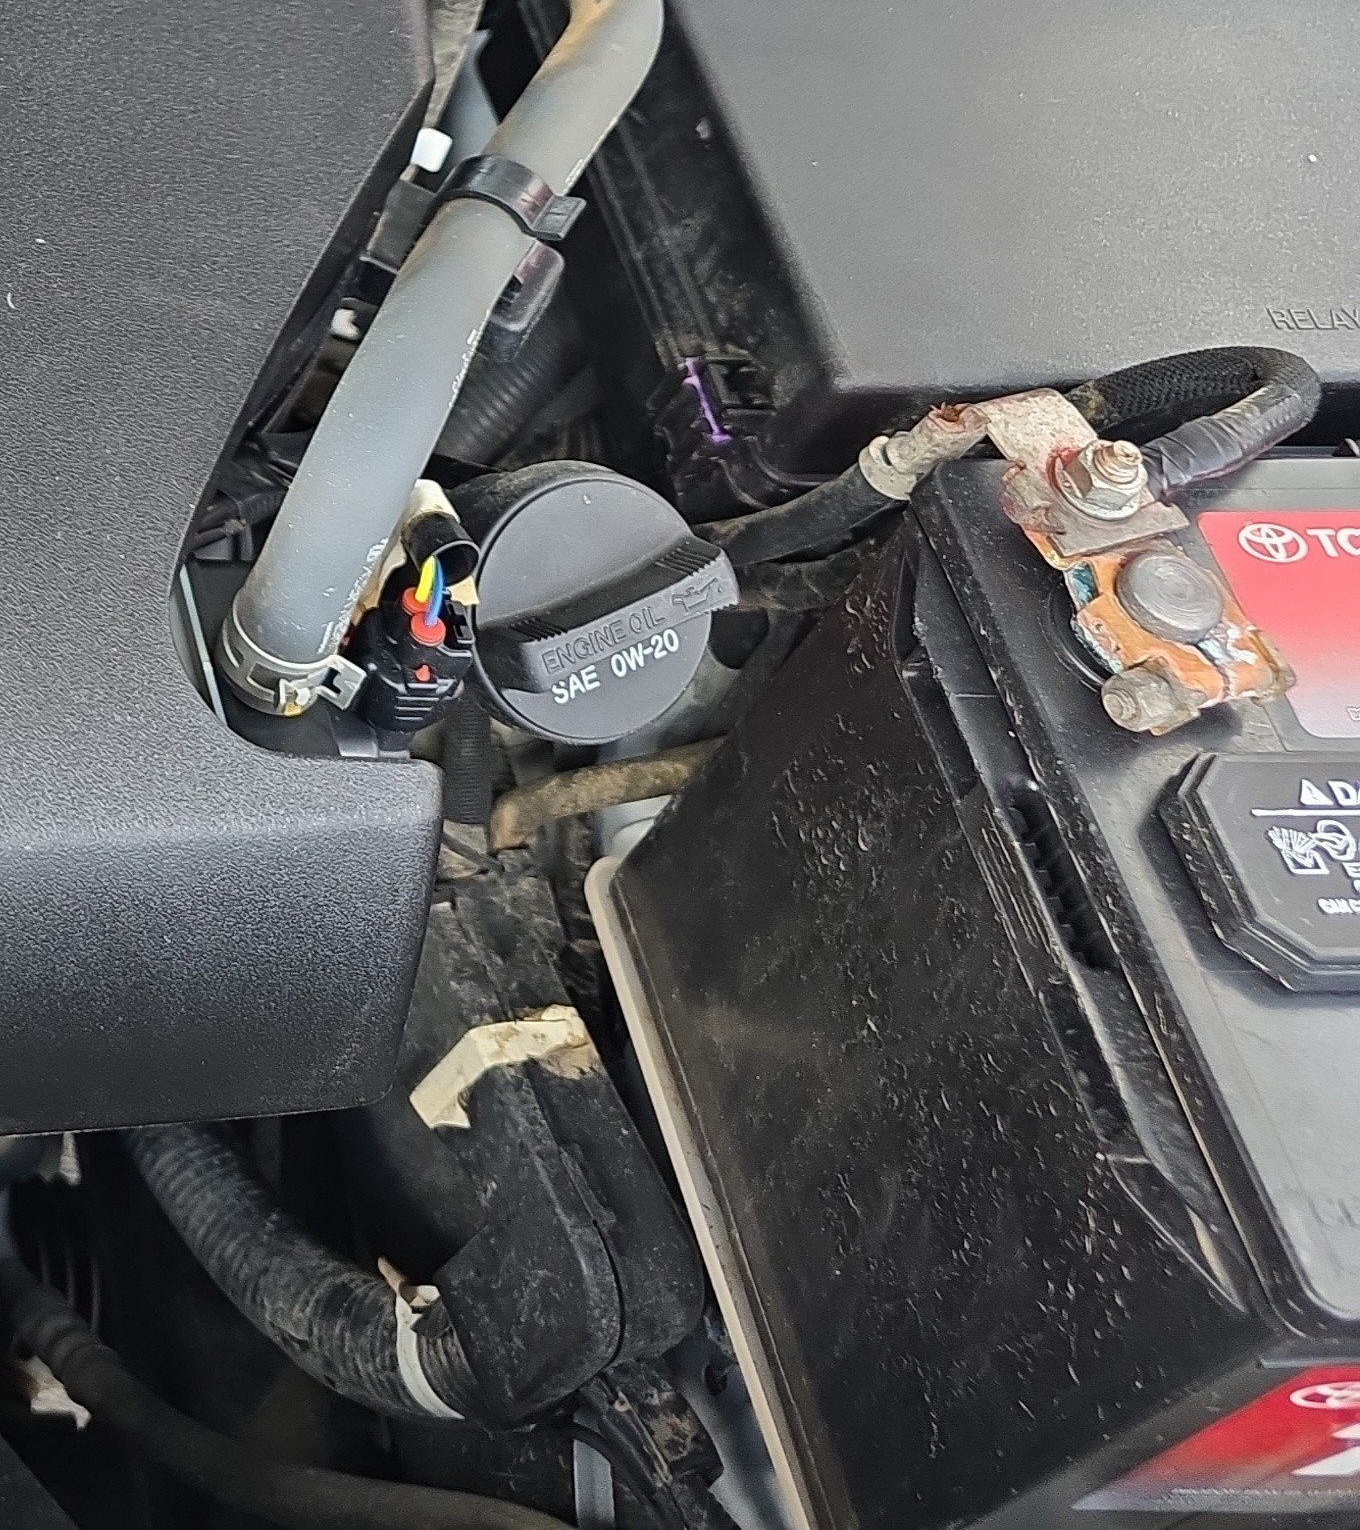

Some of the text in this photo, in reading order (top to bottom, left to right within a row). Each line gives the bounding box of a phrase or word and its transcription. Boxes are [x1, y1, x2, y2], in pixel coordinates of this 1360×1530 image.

[541, 605, 666, 675] ENGINE OIL
[551, 628, 680, 705] SAE 0W-20
